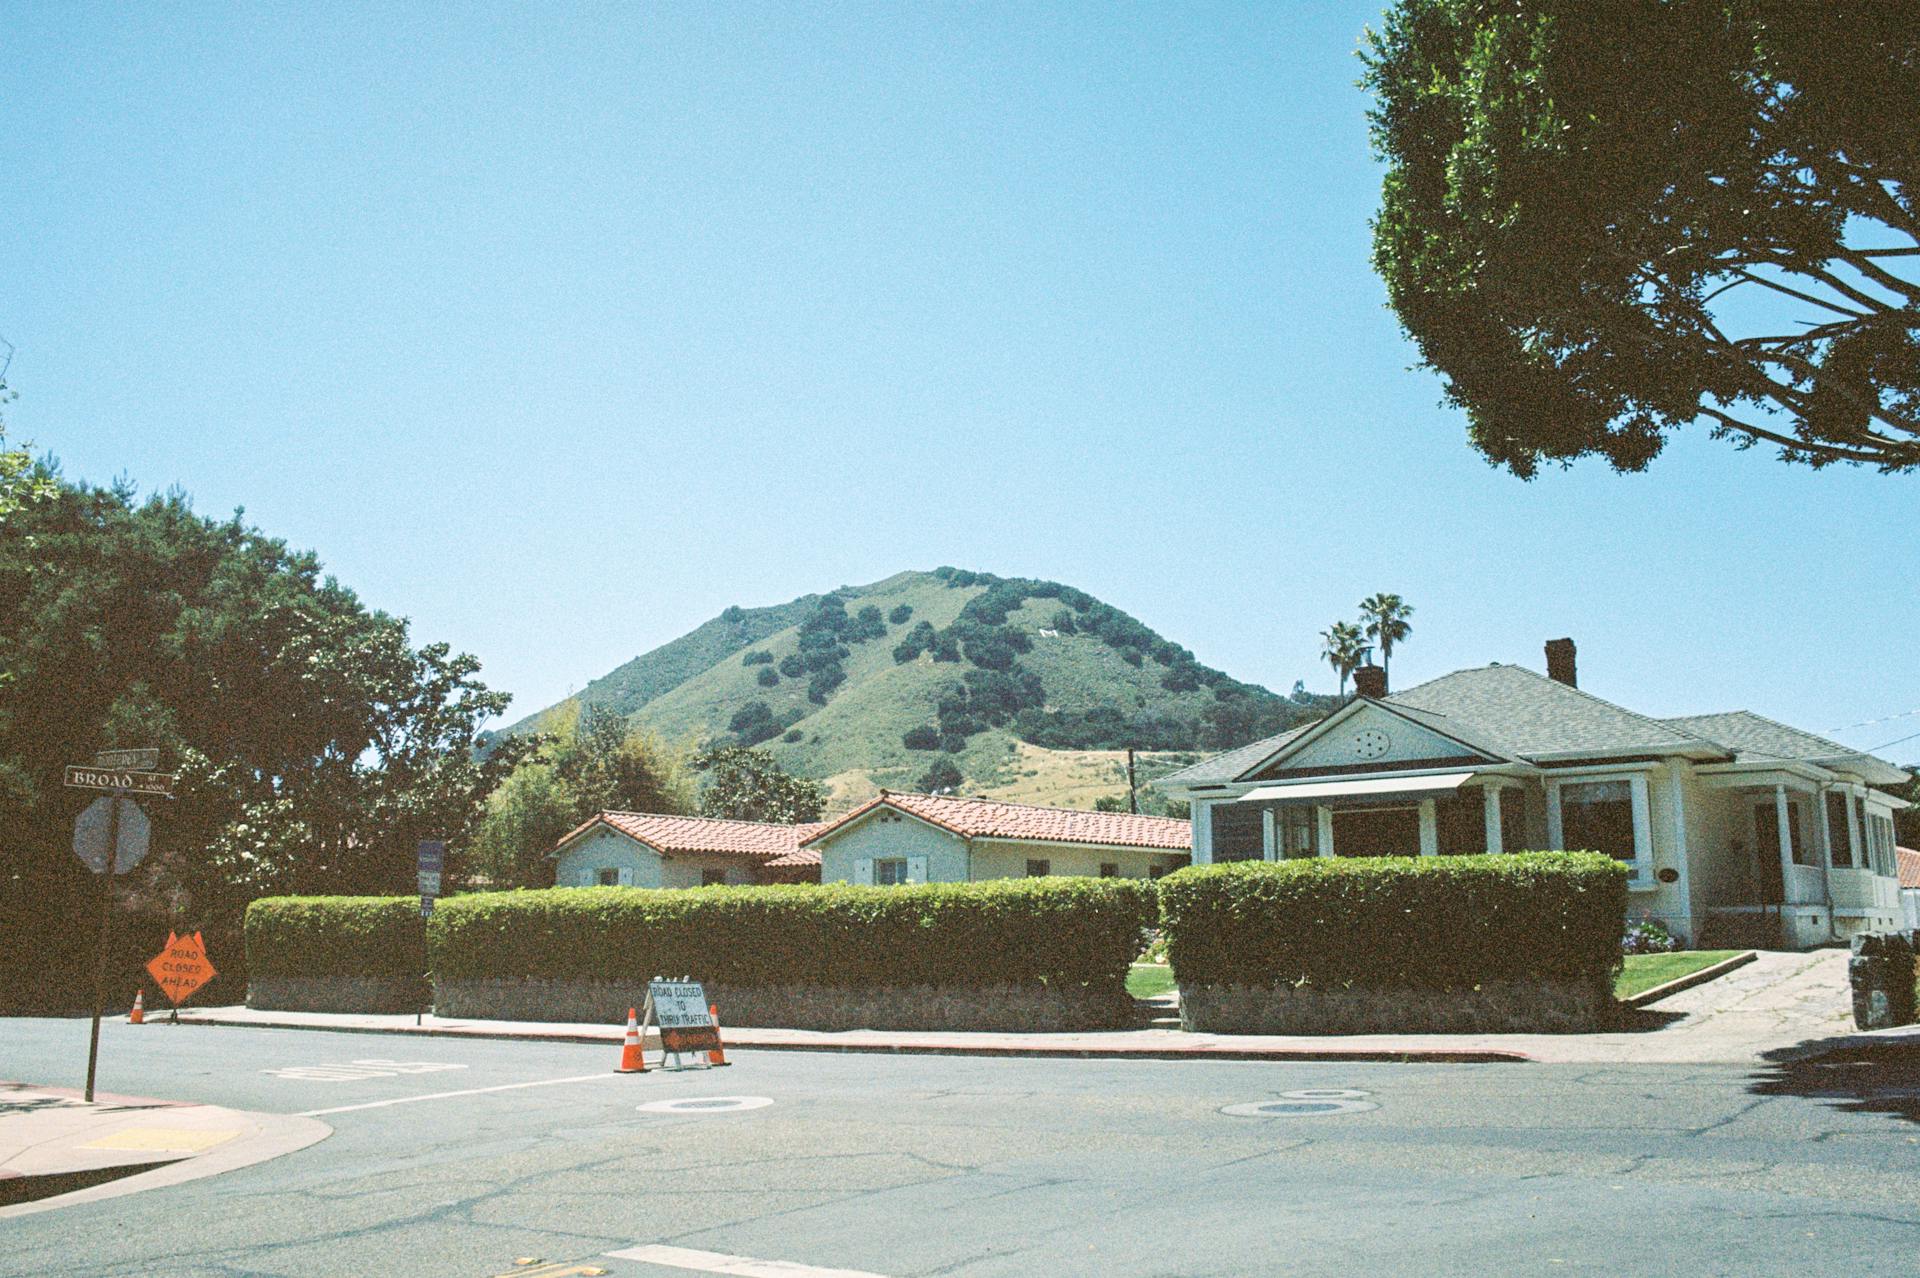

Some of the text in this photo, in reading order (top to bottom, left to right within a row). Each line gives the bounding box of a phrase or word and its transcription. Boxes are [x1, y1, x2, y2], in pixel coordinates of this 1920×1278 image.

[73, 771, 133, 788] BROAD
[171, 949, 198, 960] ROAD
[162, 962, 201, 974] CLOSED
[162, 976, 198, 988] AHEAD
[653, 986, 702, 998] ROAD CLOSED
[677, 1000, 686, 1011] TO
[660, 1013, 709, 1025] THRU TRAFFIC
